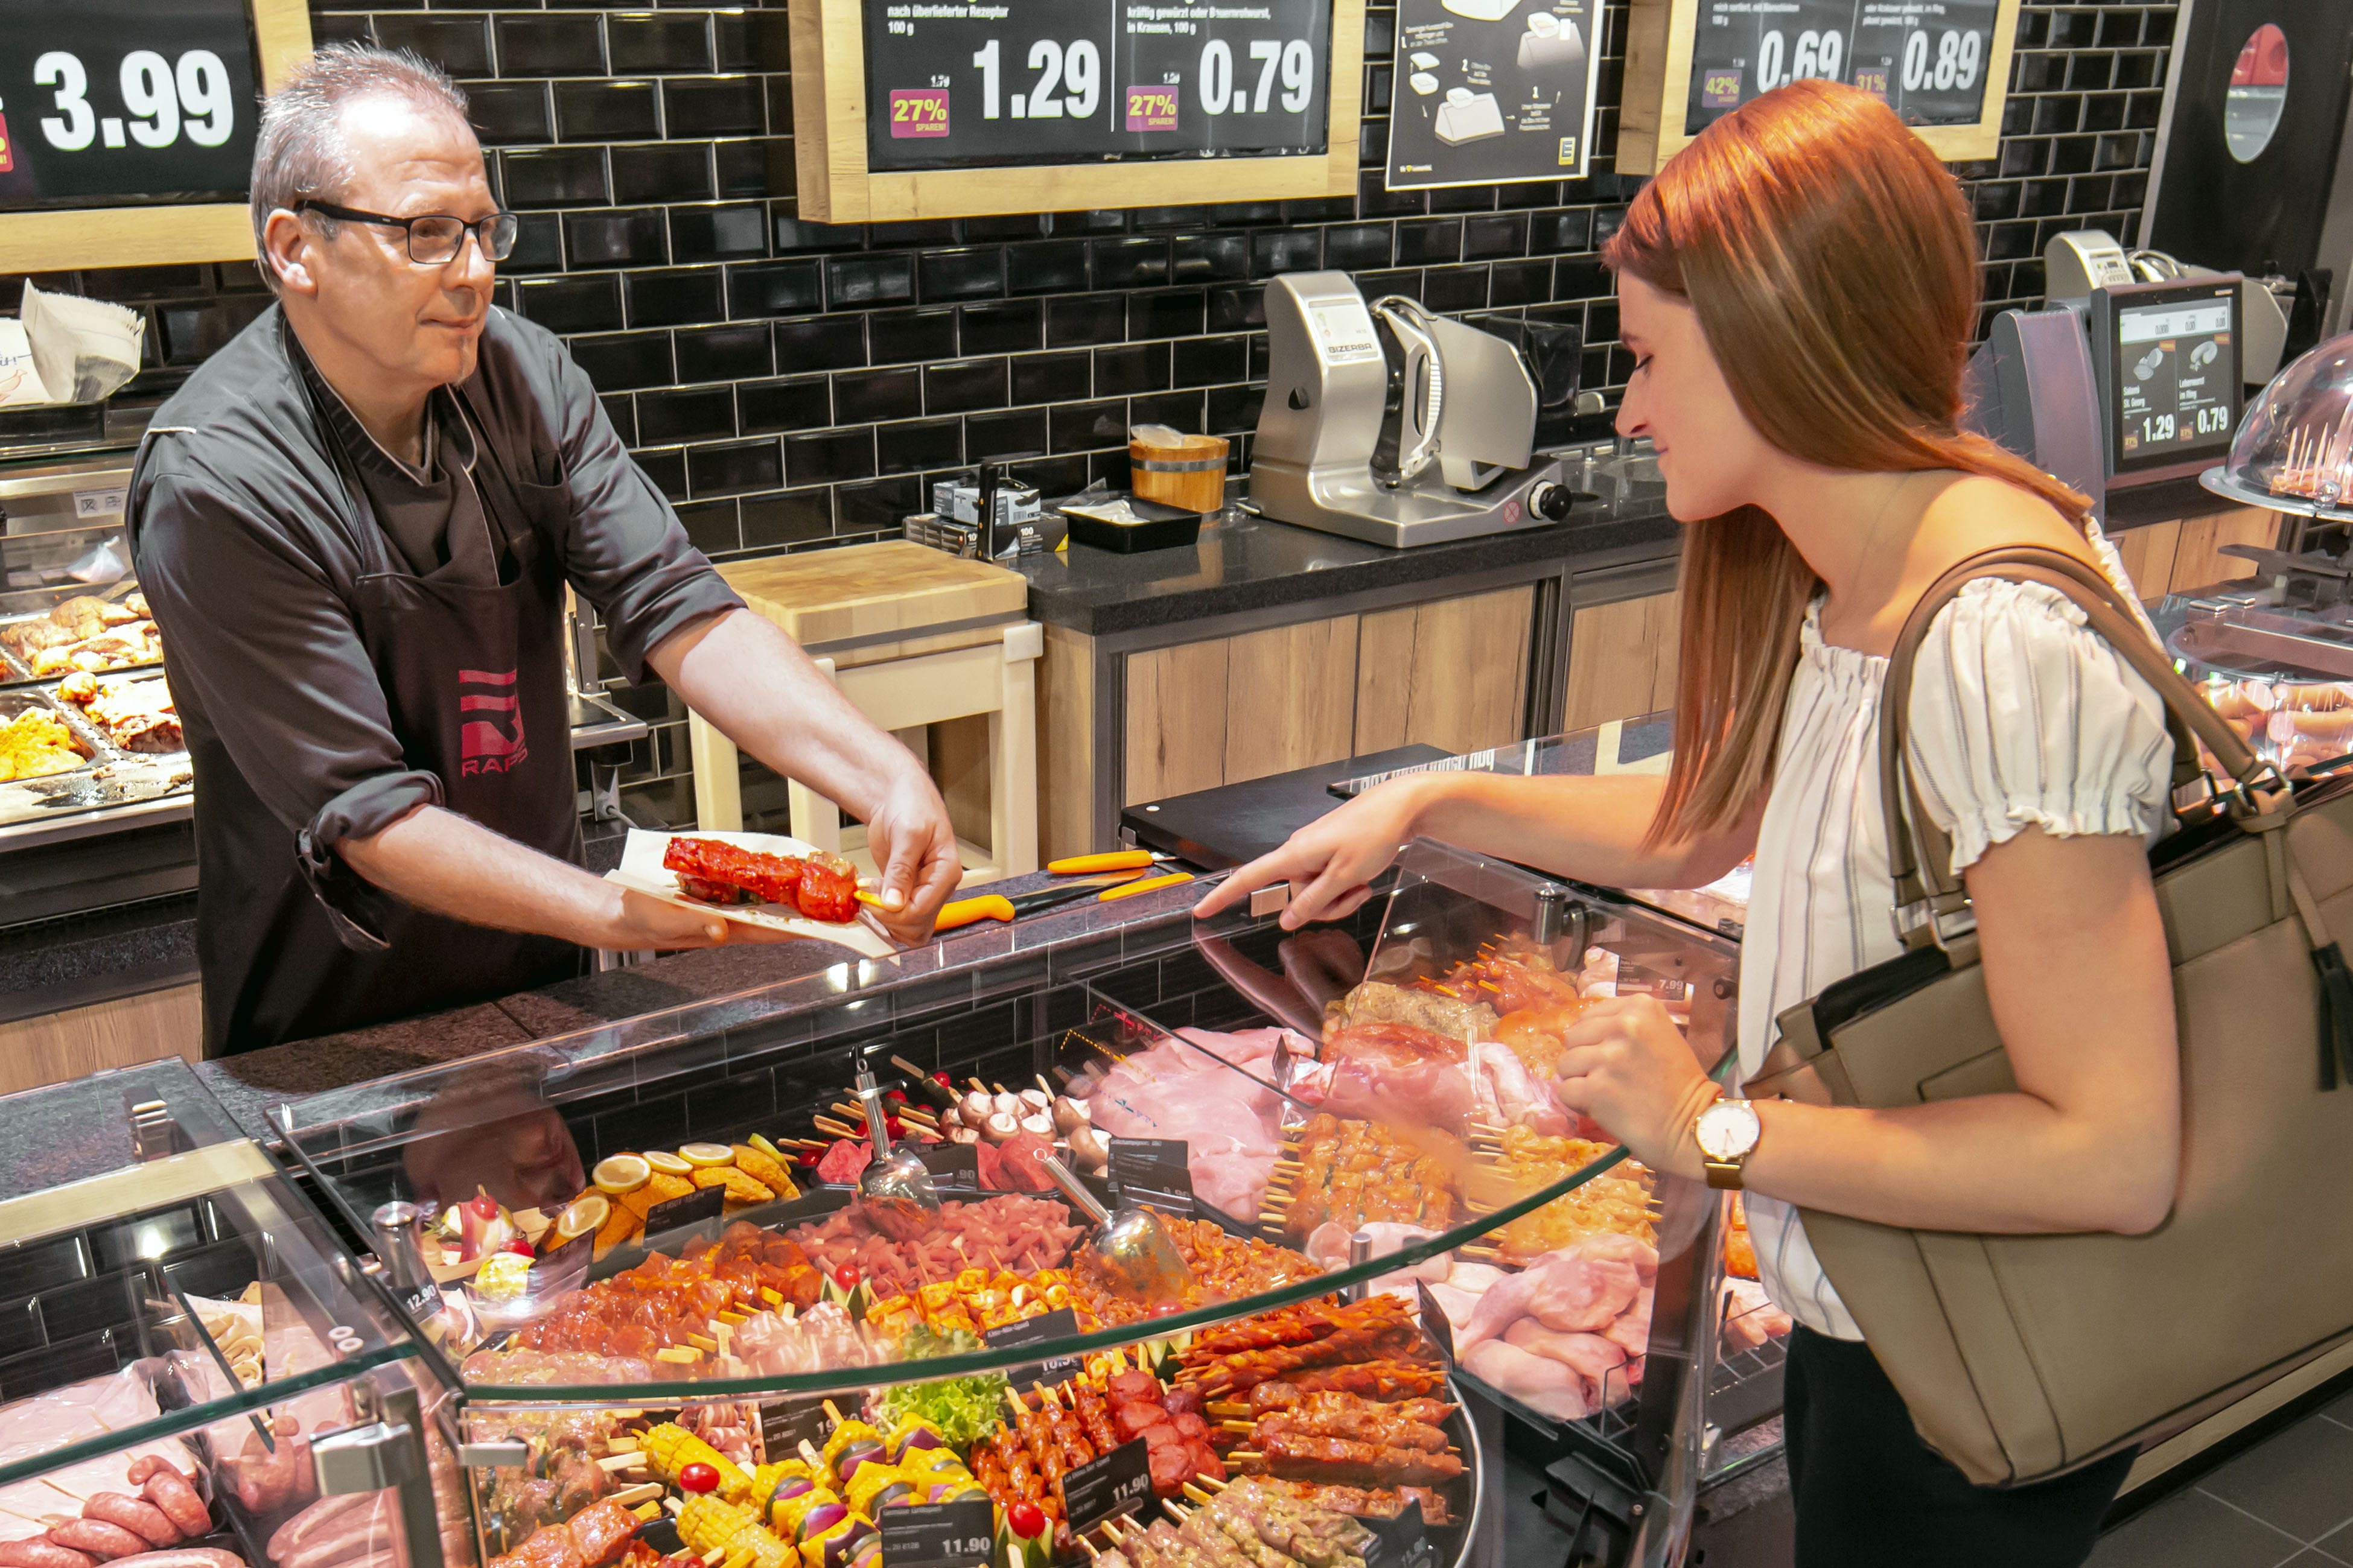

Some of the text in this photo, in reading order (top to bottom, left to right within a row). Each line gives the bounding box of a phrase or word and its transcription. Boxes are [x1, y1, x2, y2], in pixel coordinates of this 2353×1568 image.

[888, 21, 914, 36] 100 g
[1757, 30, 1842, 93] 0.69
[1903, 30, 1981, 90] 0.89
[973, 40, 1100, 119] 1.29
[1199, 39, 1314, 115] 0.79
[1705, 76, 1739, 94] 42%
[34, 49, 234, 151] 3.99
[894, 98, 947, 121] 27%
[1129, 94, 1176, 116] 27%
[1328, 343, 1372, 354] BIZERBA
[2144, 413, 2174, 442] 1.29
[2197, 405, 2228, 434] 0.79
[1659, 979, 1684, 990] 7.99
[407, 1284, 436, 1311] 12.90
[1112, 1473, 1148, 1502] 11.90
[942, 1537, 991, 1554] 11.90
